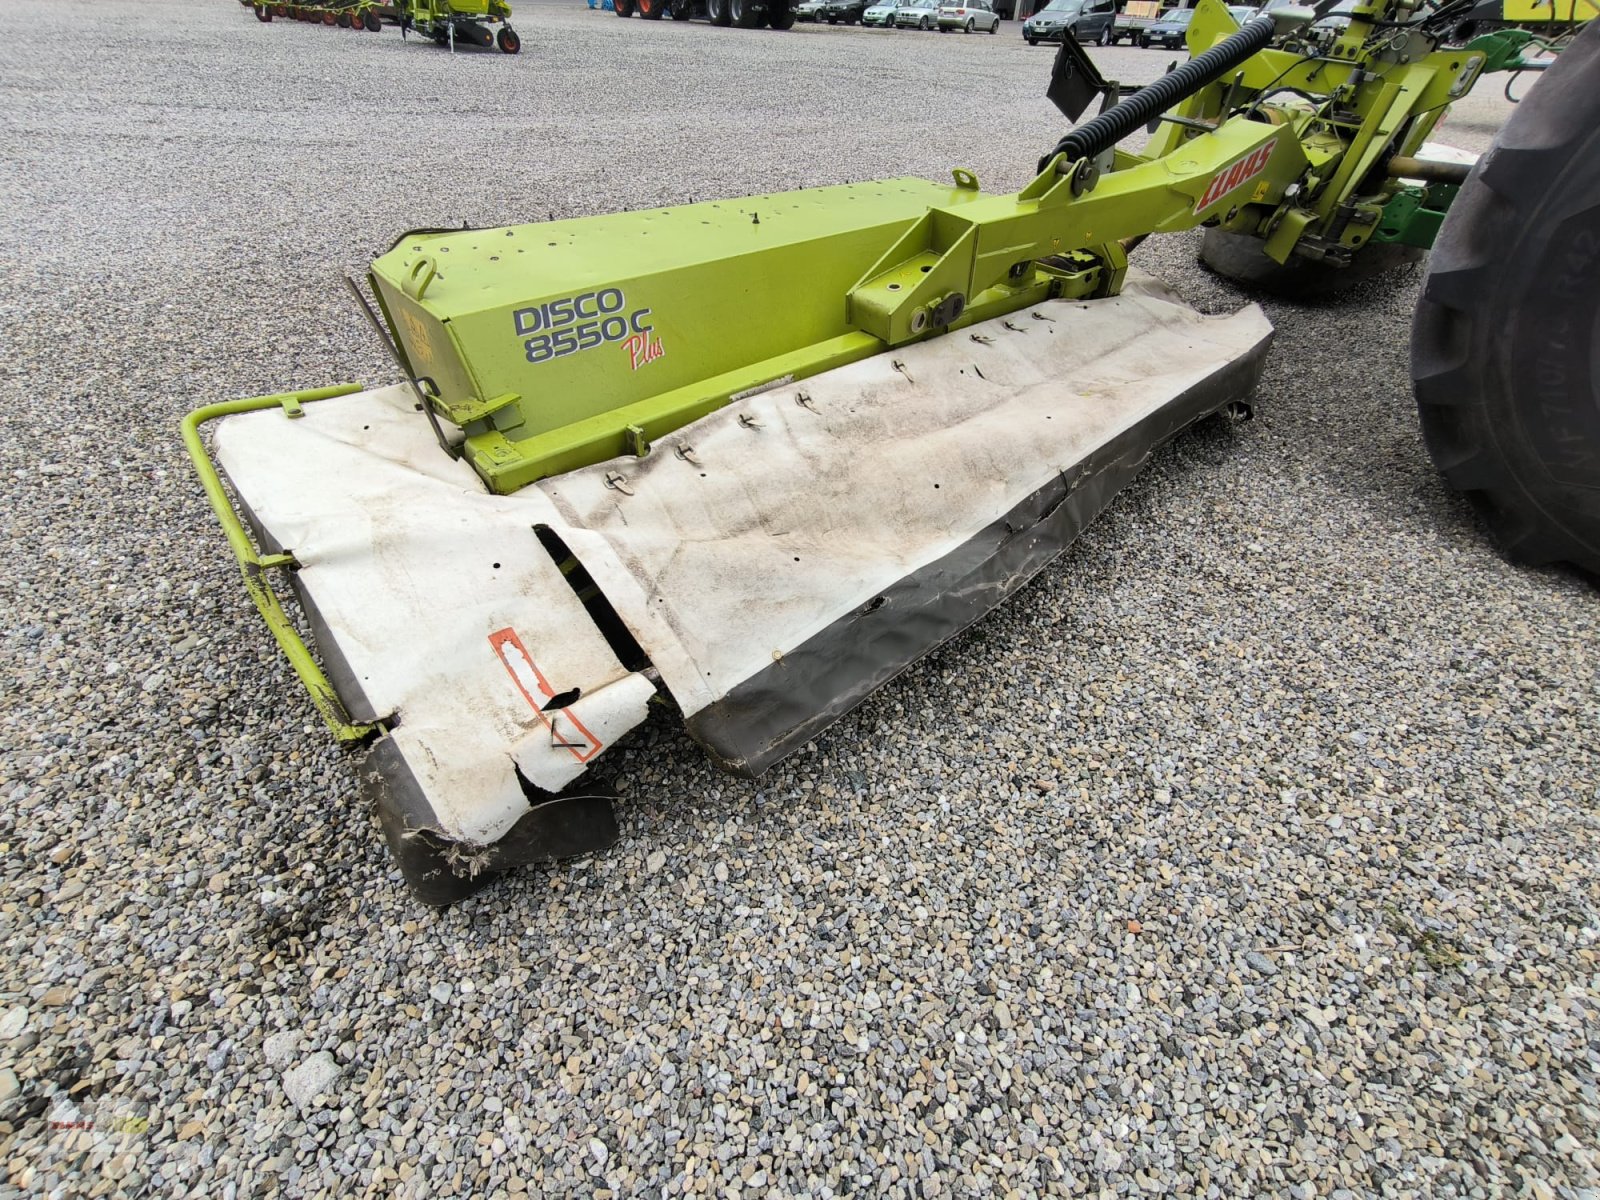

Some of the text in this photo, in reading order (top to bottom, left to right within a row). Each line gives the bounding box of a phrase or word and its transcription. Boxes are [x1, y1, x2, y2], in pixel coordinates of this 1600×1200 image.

[1196, 139, 1276, 211] CLAAS
[513, 288, 625, 336] DISCO
[621, 329, 665, 371] Plus
